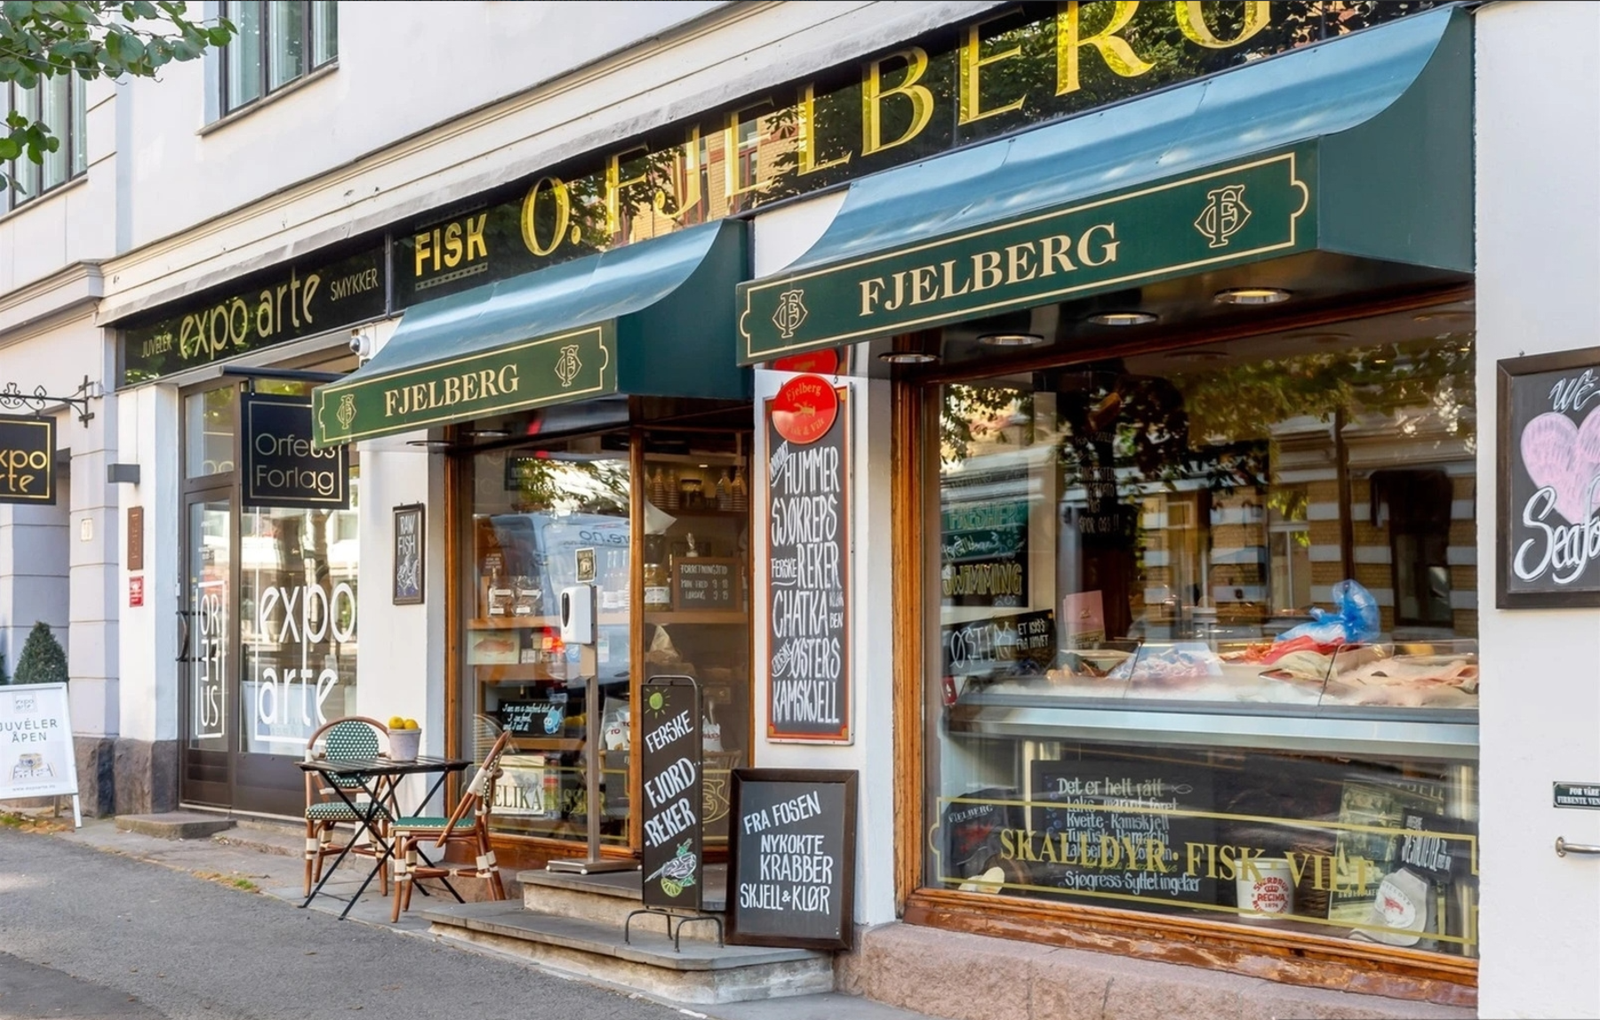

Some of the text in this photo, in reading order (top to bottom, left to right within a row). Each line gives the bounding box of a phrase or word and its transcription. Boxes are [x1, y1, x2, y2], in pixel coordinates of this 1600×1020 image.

[415, 213, 488, 277] FISK
[859, 222, 1120, 318] FJELBERG
[179, 296, 249, 360] expo
[256, 265, 321, 338] arte
[331, 268, 379, 301] SMYKKER
[384, 364, 520, 417] FJELBERG
[786, 381, 822, 402] Fjelberg
[256, 465, 334, 496] Forlag
[784, 446, 841, 495] HUMMER
[771, 494, 839, 547] SJØKREPS
[771, 540, 843, 590] FERSKE REKER
[259, 582, 357, 644] expo
[772, 589, 829, 639] CHATKA
[786, 637, 841, 679] ØSTERS
[259, 666, 339, 728] arte
[772, 679, 841, 724] KAMSKJELL
[11, 731, 48, 743] ÅPEN
[645, 709, 694, 754] FERSKE
[1057, 776, 1083, 795] Det
[1085, 780, 1102, 796] er
[1104, 776, 1134, 797] helt
[743, 791, 821, 835] FRA FOSEN
[1066, 812, 1105, 829] Kveite
[1110, 814, 1170, 833] Kamskjell
[761, 834, 825, 854] NYKOKTE
[1184, 841, 1265, 885] FISK
[760, 854, 834, 885] KRABBER
